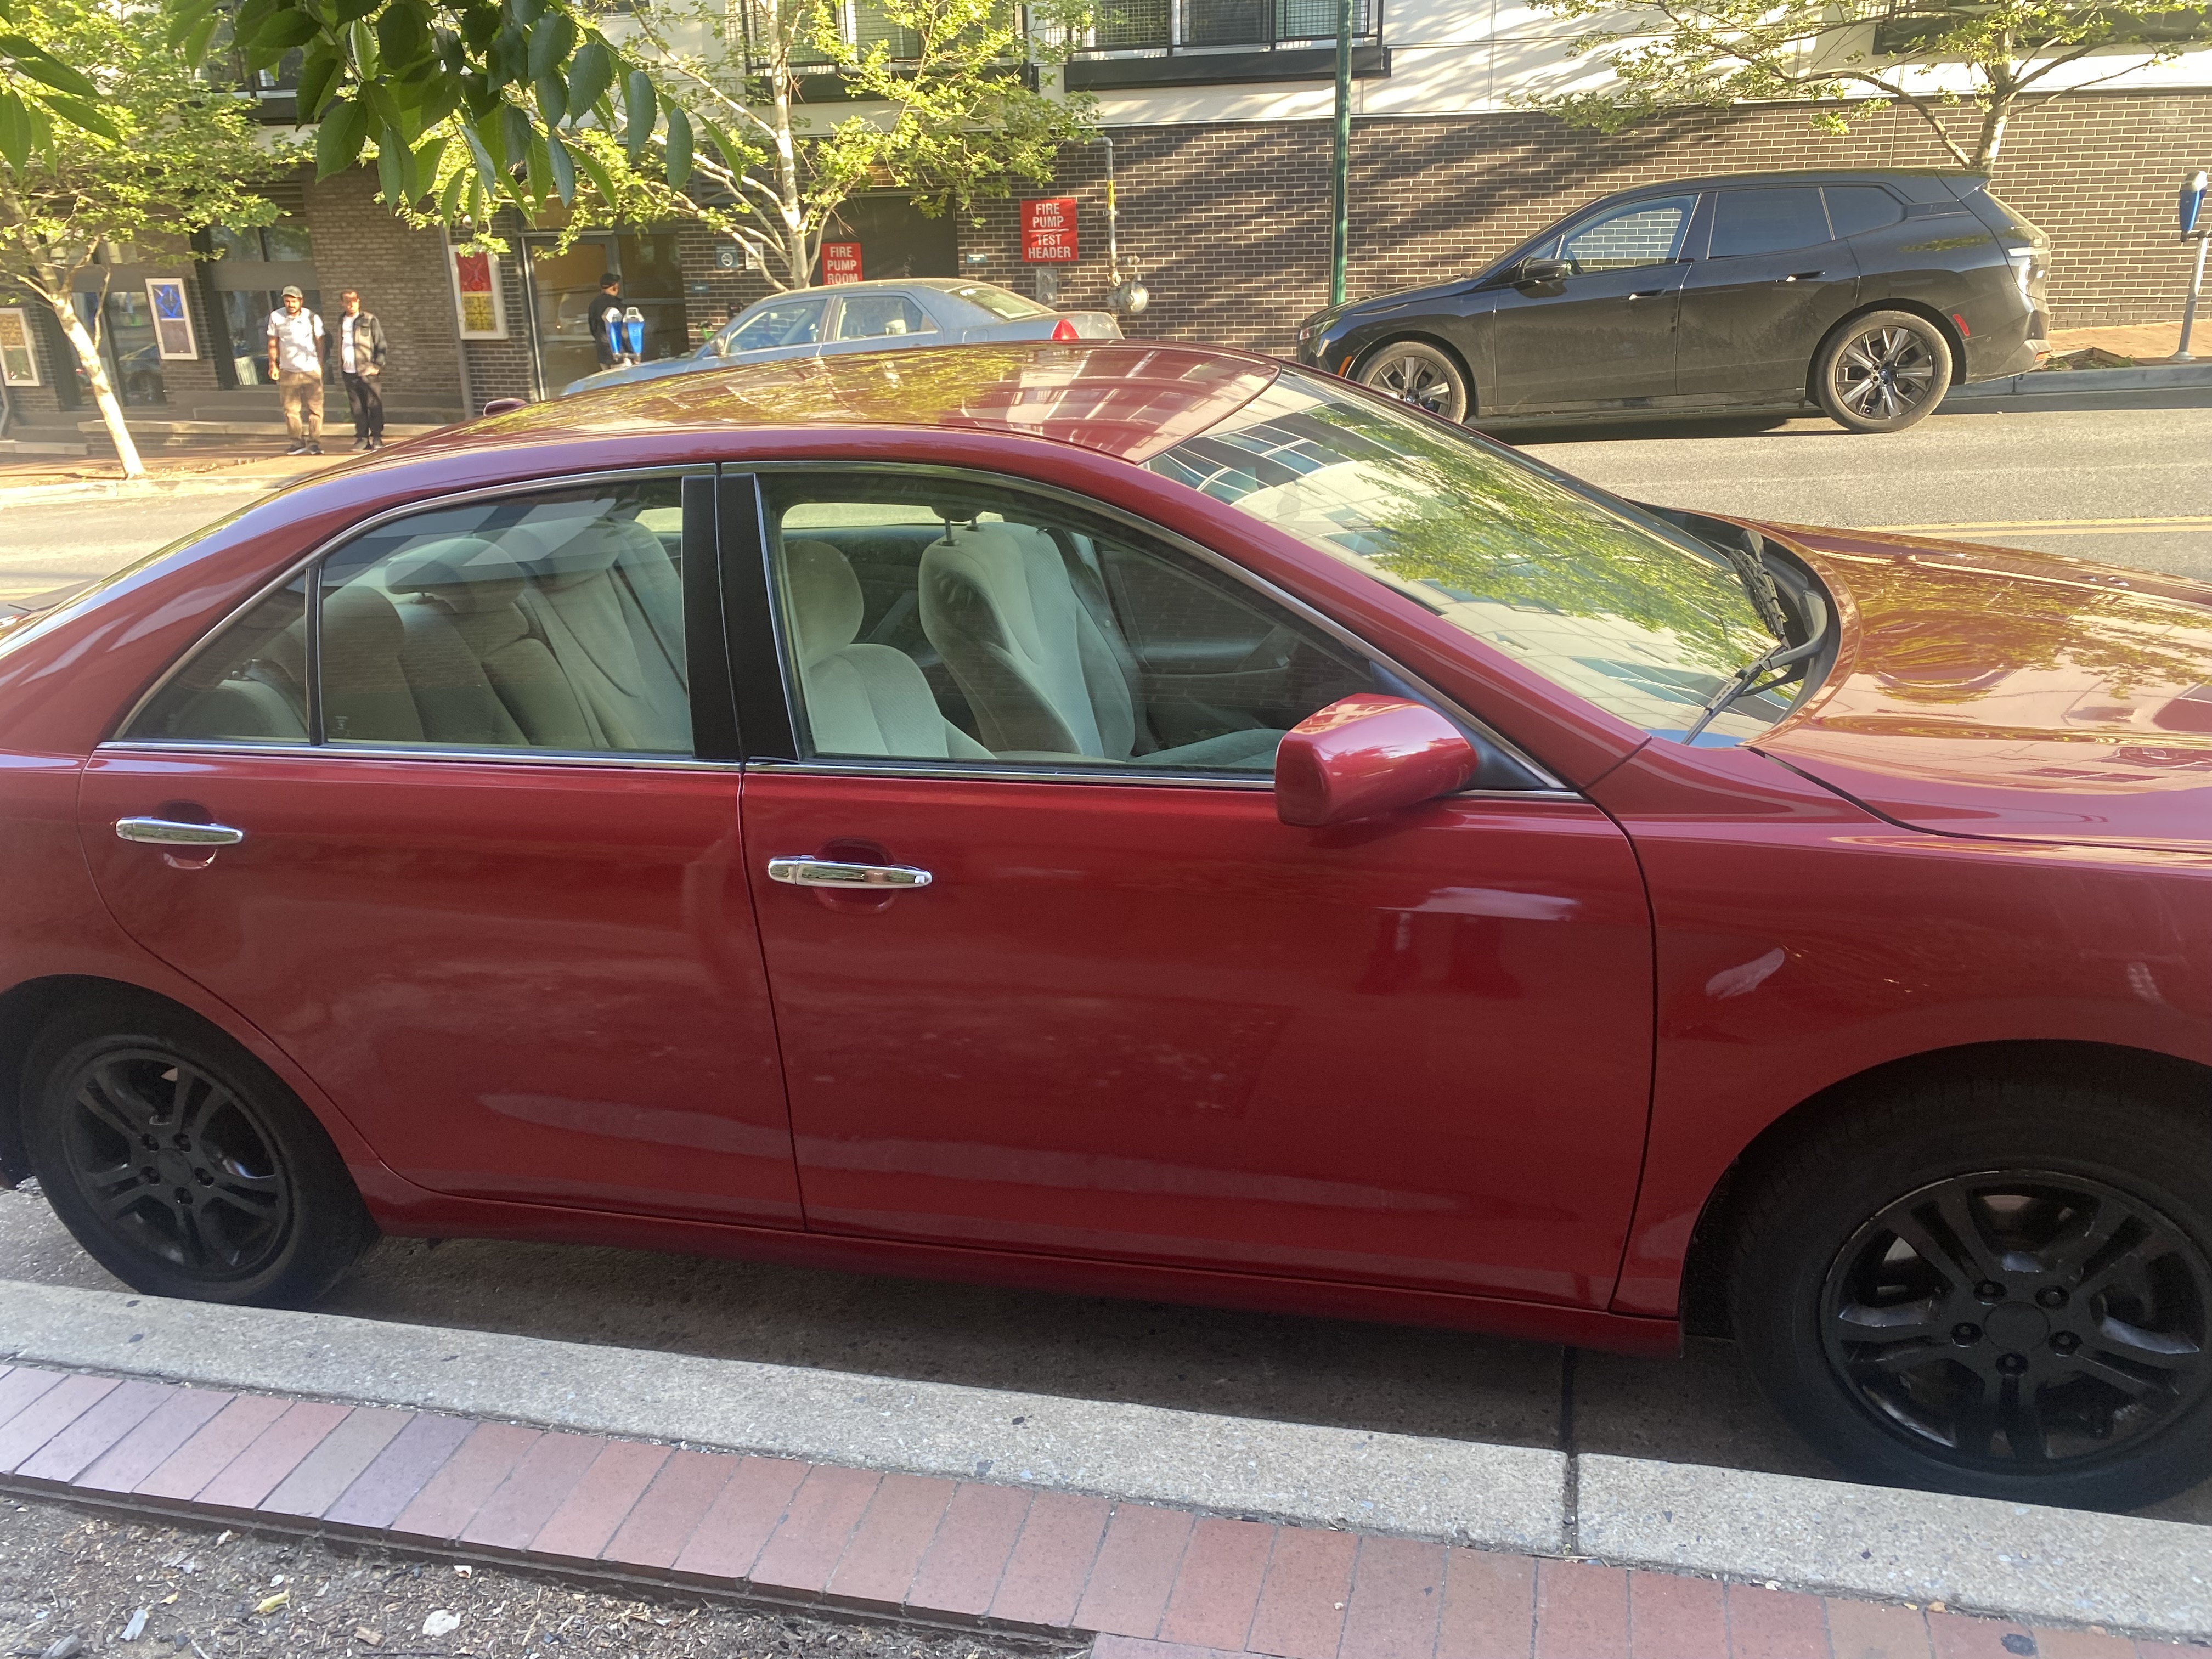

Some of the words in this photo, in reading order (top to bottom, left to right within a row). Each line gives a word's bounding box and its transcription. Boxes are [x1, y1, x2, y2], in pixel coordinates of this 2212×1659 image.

[1035, 202, 1060, 215] FIRE
[1032, 216, 1064, 228] PUMP
[1036, 234, 1062, 245] TEST
[830, 246, 853, 257] FIRE
[1028, 246, 1071, 259] HEADER
[827, 259, 857, 271] PUMP
[827, 273, 858, 284] ROOM
